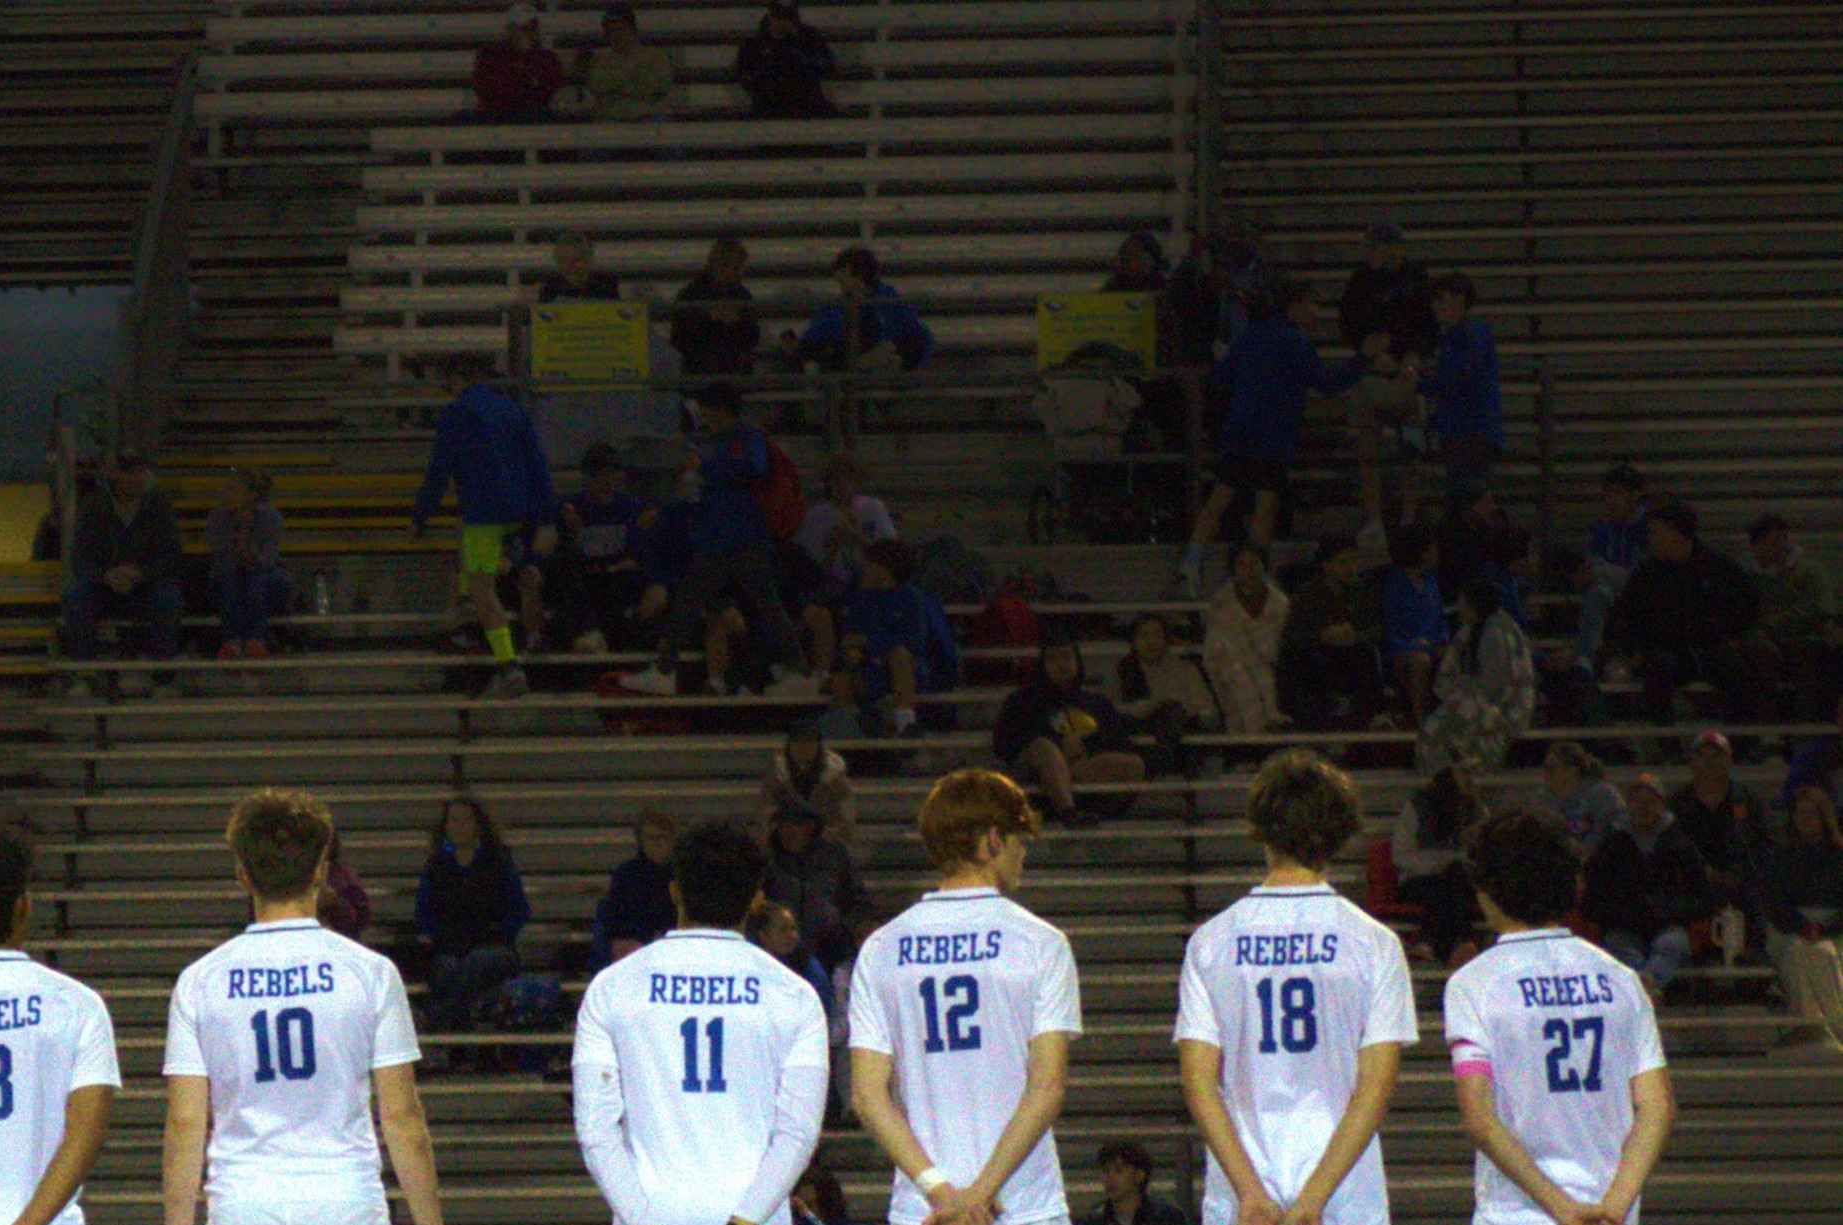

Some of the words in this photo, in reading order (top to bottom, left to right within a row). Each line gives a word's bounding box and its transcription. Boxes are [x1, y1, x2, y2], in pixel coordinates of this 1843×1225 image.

[229, 963, 336, 998] REBELS
[897, 931, 1003, 966] REBELS
[1236, 933, 1339, 966] REBELS
[650, 973, 762, 1005] REBELS
[920, 976, 982, 1051] 12
[1258, 978, 1318, 1053] 18
[252, 1008, 317, 1083] 10
[681, 1018, 727, 1092] 11
[1544, 1017, 1605, 1092] 27
